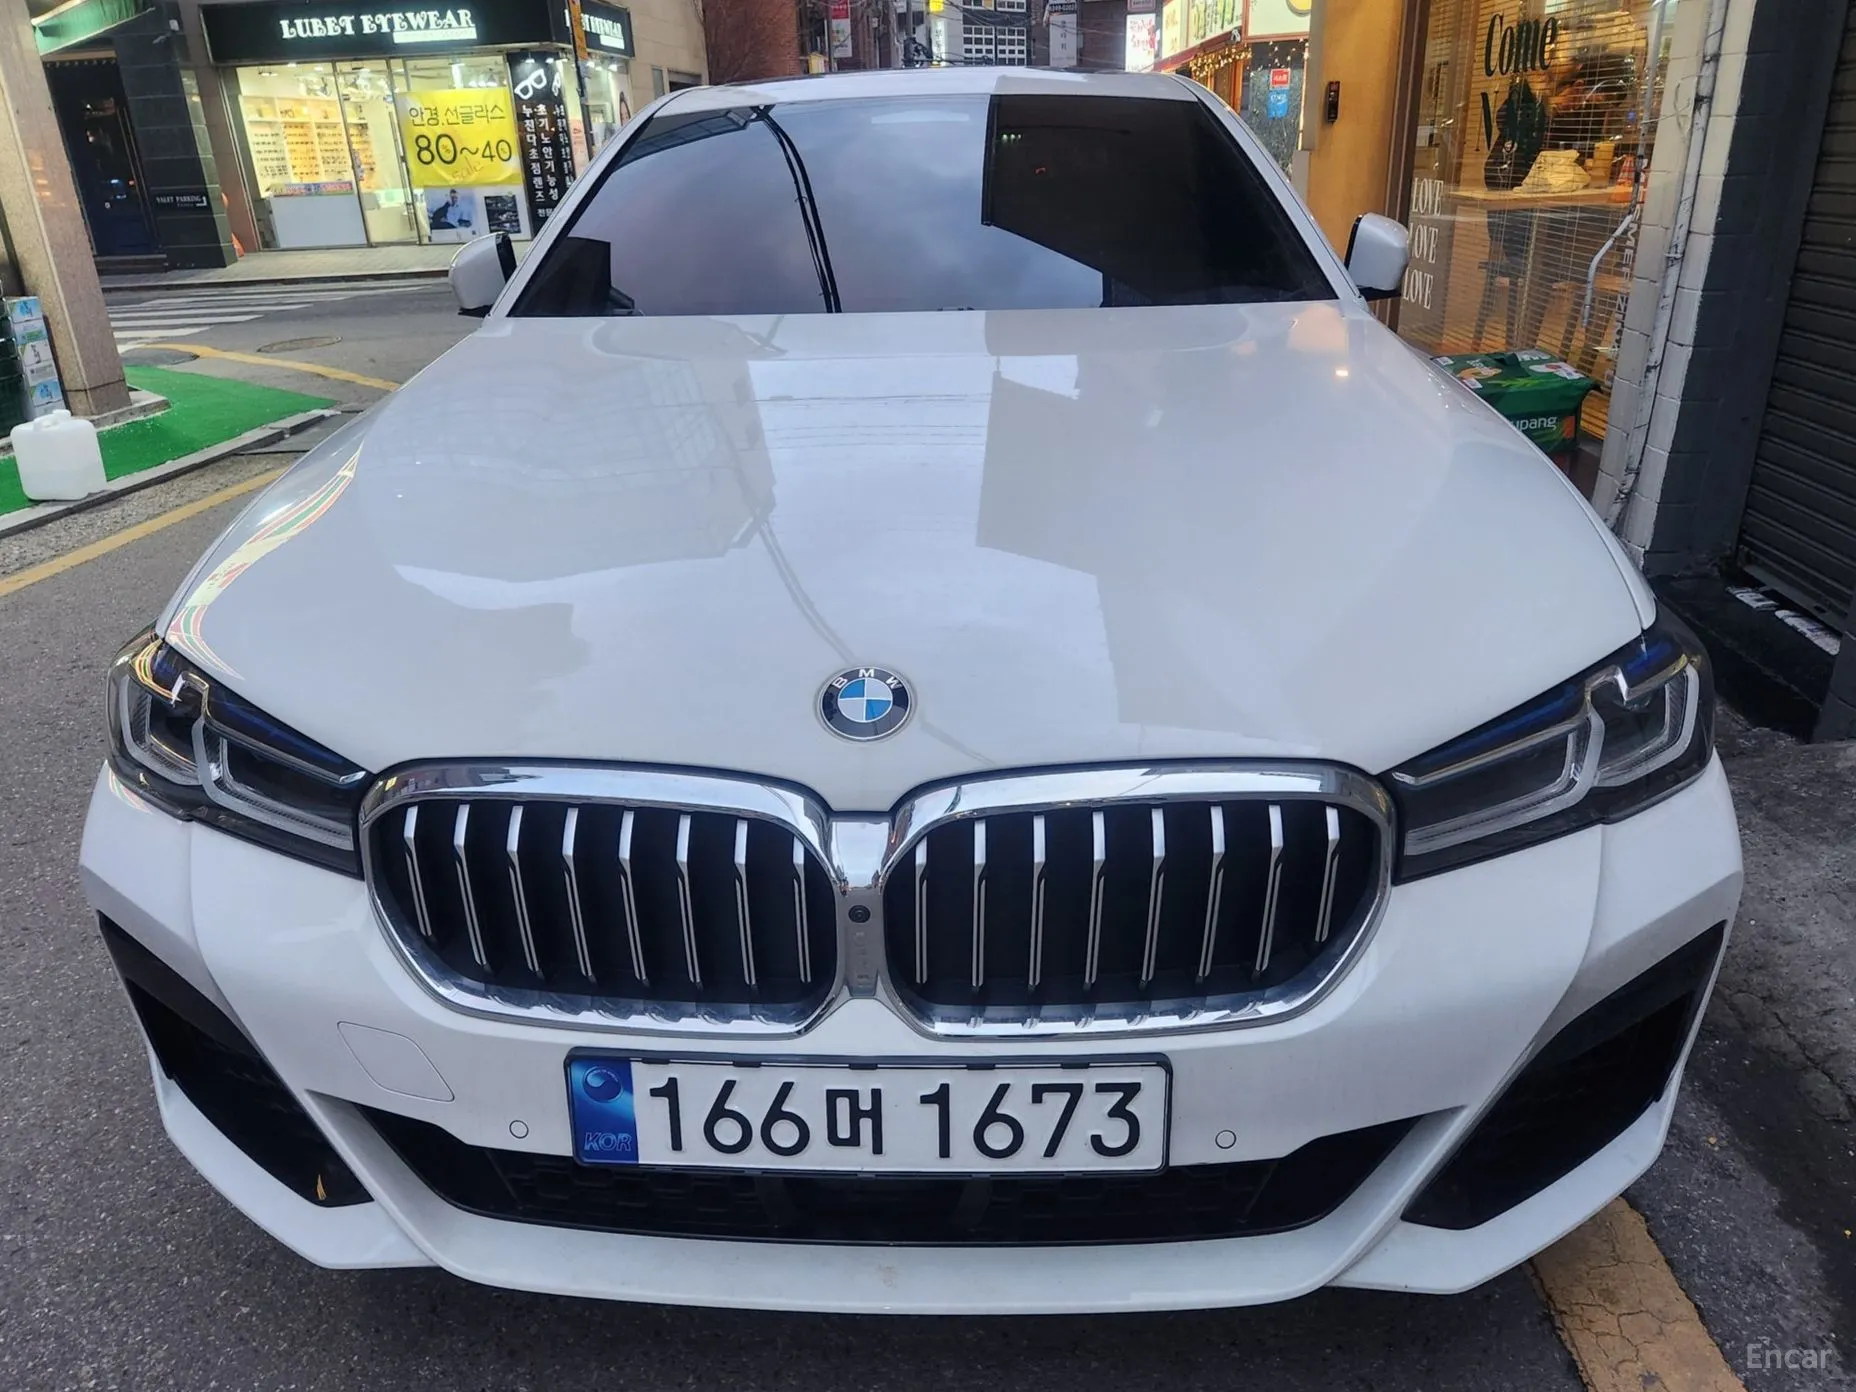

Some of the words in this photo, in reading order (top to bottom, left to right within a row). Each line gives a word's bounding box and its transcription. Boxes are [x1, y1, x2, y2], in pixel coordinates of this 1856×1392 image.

[280, 15, 355, 39] LUBET
[360, 9, 475, 34] EYEWEAR
[1485, 13, 1557, 77] Come
[1412, 177, 1444, 217] LOVE
[1403, 267, 1434, 310] LOVE
[832, 668, 904, 690] BMW
[649, 1076, 884, 1156] 166머
[919, 1081, 1142, 1160] 1673
[584, 1131, 632, 1152] KOR
